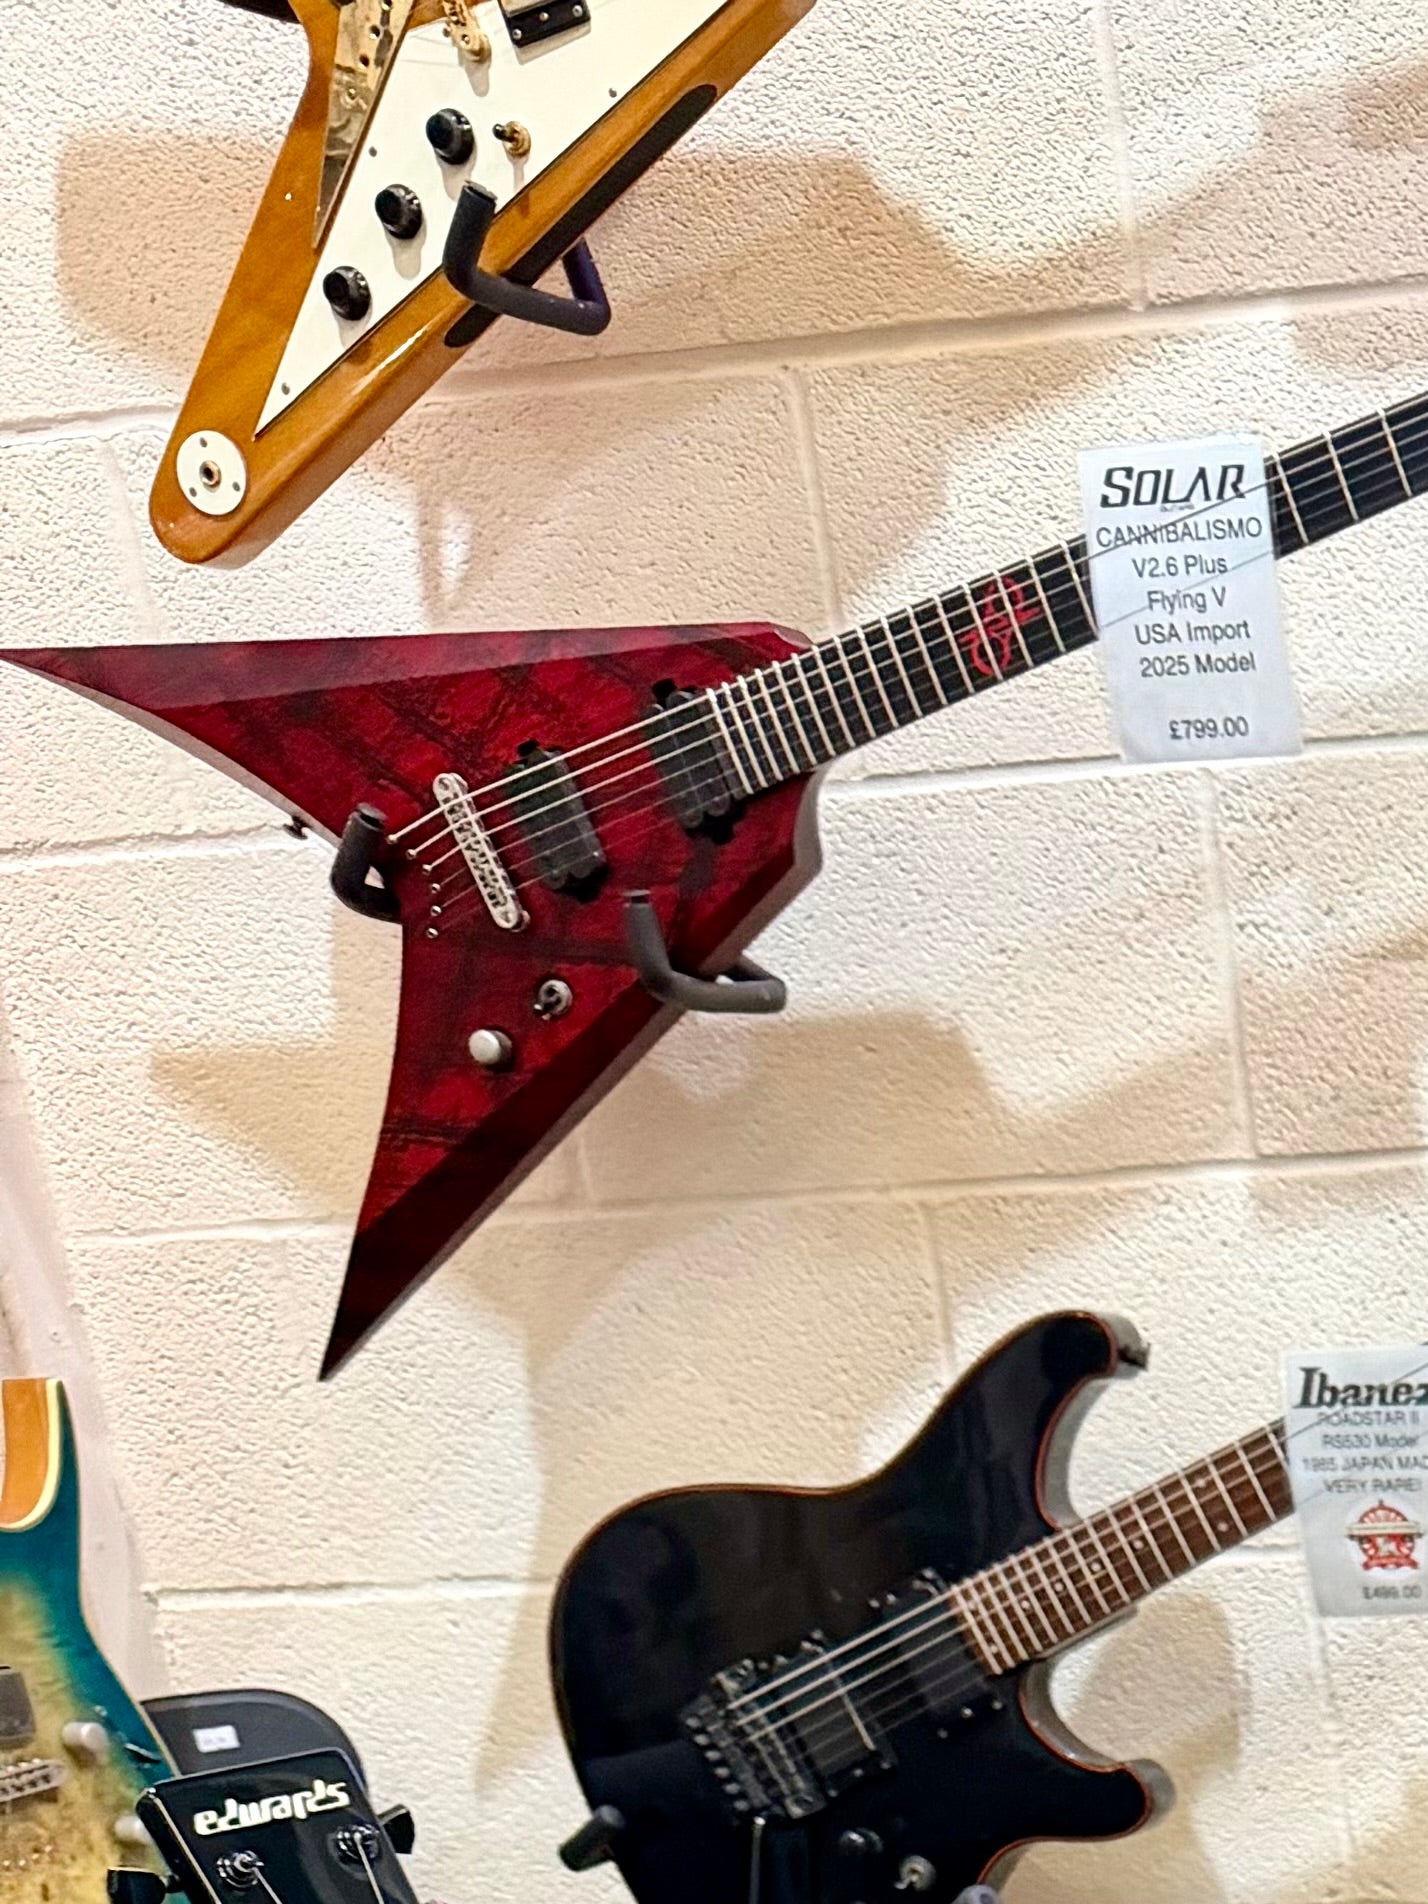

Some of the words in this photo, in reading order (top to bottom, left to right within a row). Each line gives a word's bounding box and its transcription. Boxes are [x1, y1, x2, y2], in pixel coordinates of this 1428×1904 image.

[1100, 464, 1246, 508] SOLAR
[1096, 517, 1262, 548] CANNIBALISMO
[1132, 558, 1178, 578] V2.6
[1184, 556, 1228, 576] Plus
[1148, 589, 1207, 614] Flying
[1211, 586, 1226, 607] V
[1135, 624, 1181, 645] USA
[1188, 620, 1251, 646] Import
[1140, 656, 1190, 678] 2025
[1195, 652, 1256, 674] Model
[1169, 717, 1248, 740] £799.00
[1317, 1410, 1406, 1427] ROADSTAR
[1341, 1456, 1393, 1471] JAPAN
[1324, 1480, 1368, 1494] VERY
[193, 1779, 350, 1837] edwards
